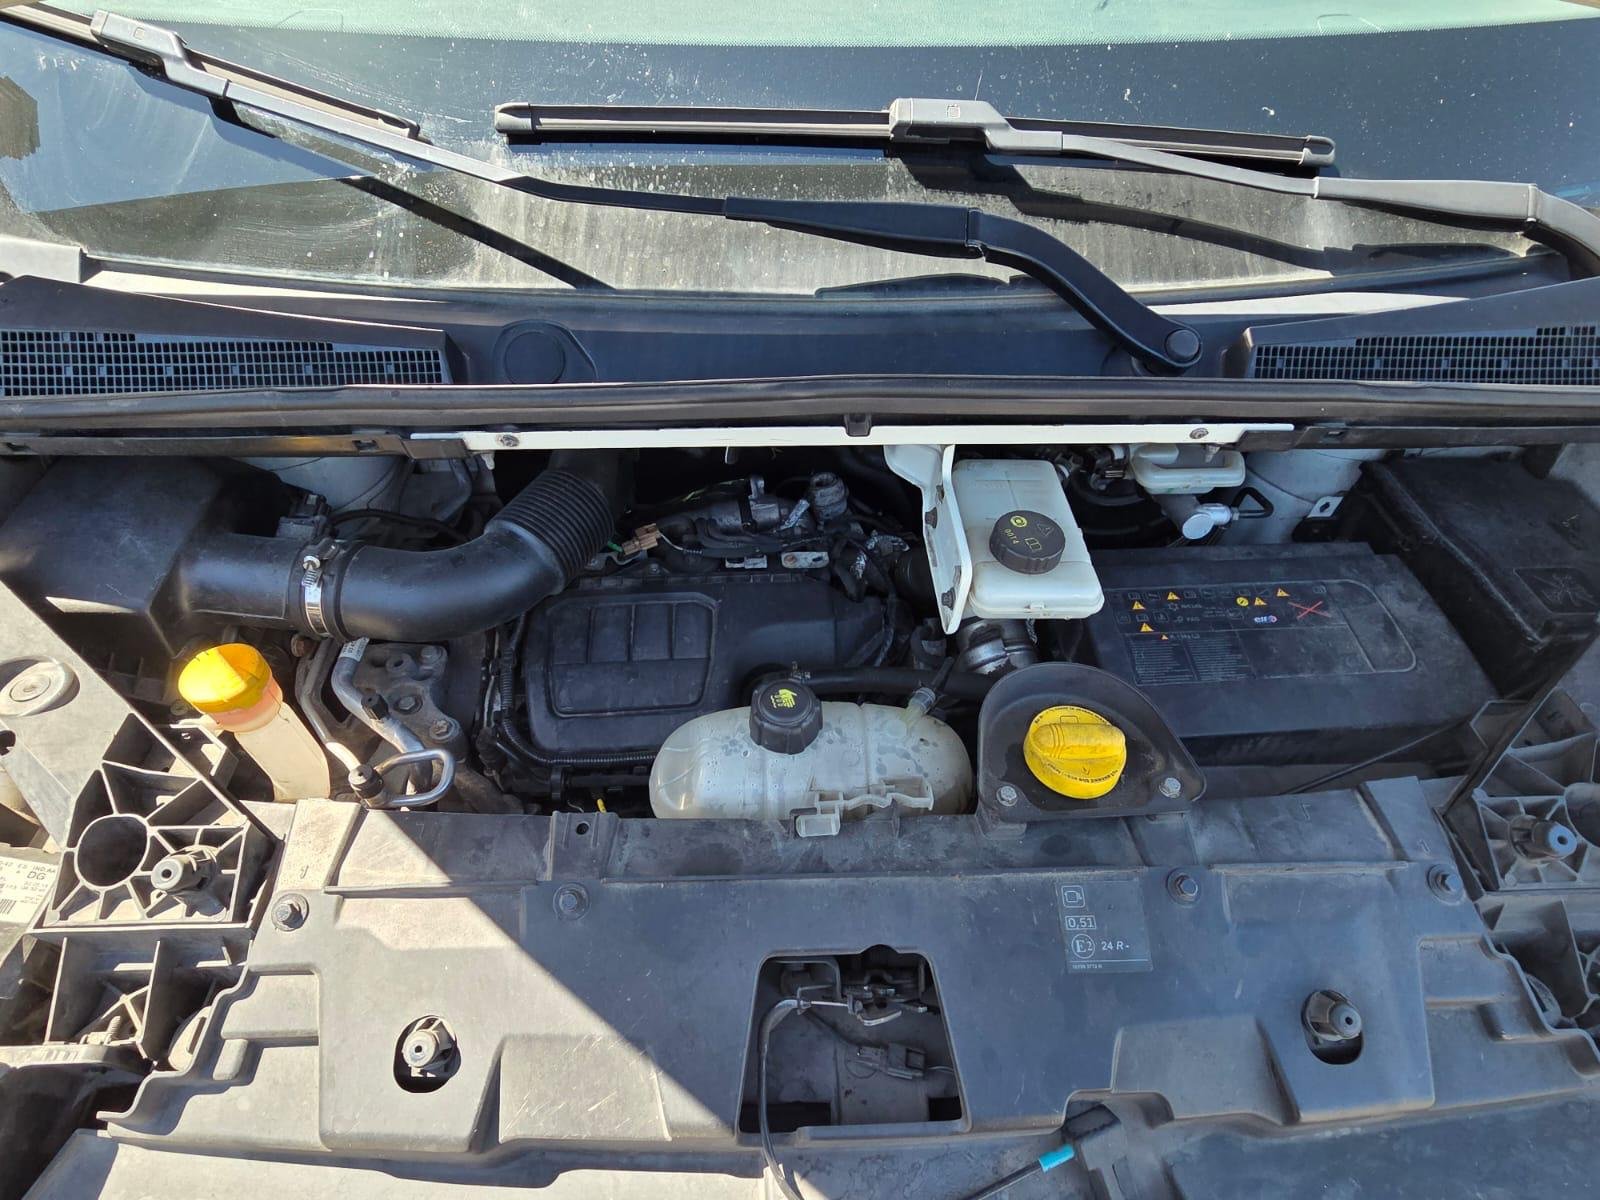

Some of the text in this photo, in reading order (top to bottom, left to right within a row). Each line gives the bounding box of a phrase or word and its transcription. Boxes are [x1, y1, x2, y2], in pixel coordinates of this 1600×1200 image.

[27, 871, 46, 880] DG
[1068, 918, 1094, 930] 0,51
[1101, 940, 1113, 951] 24
